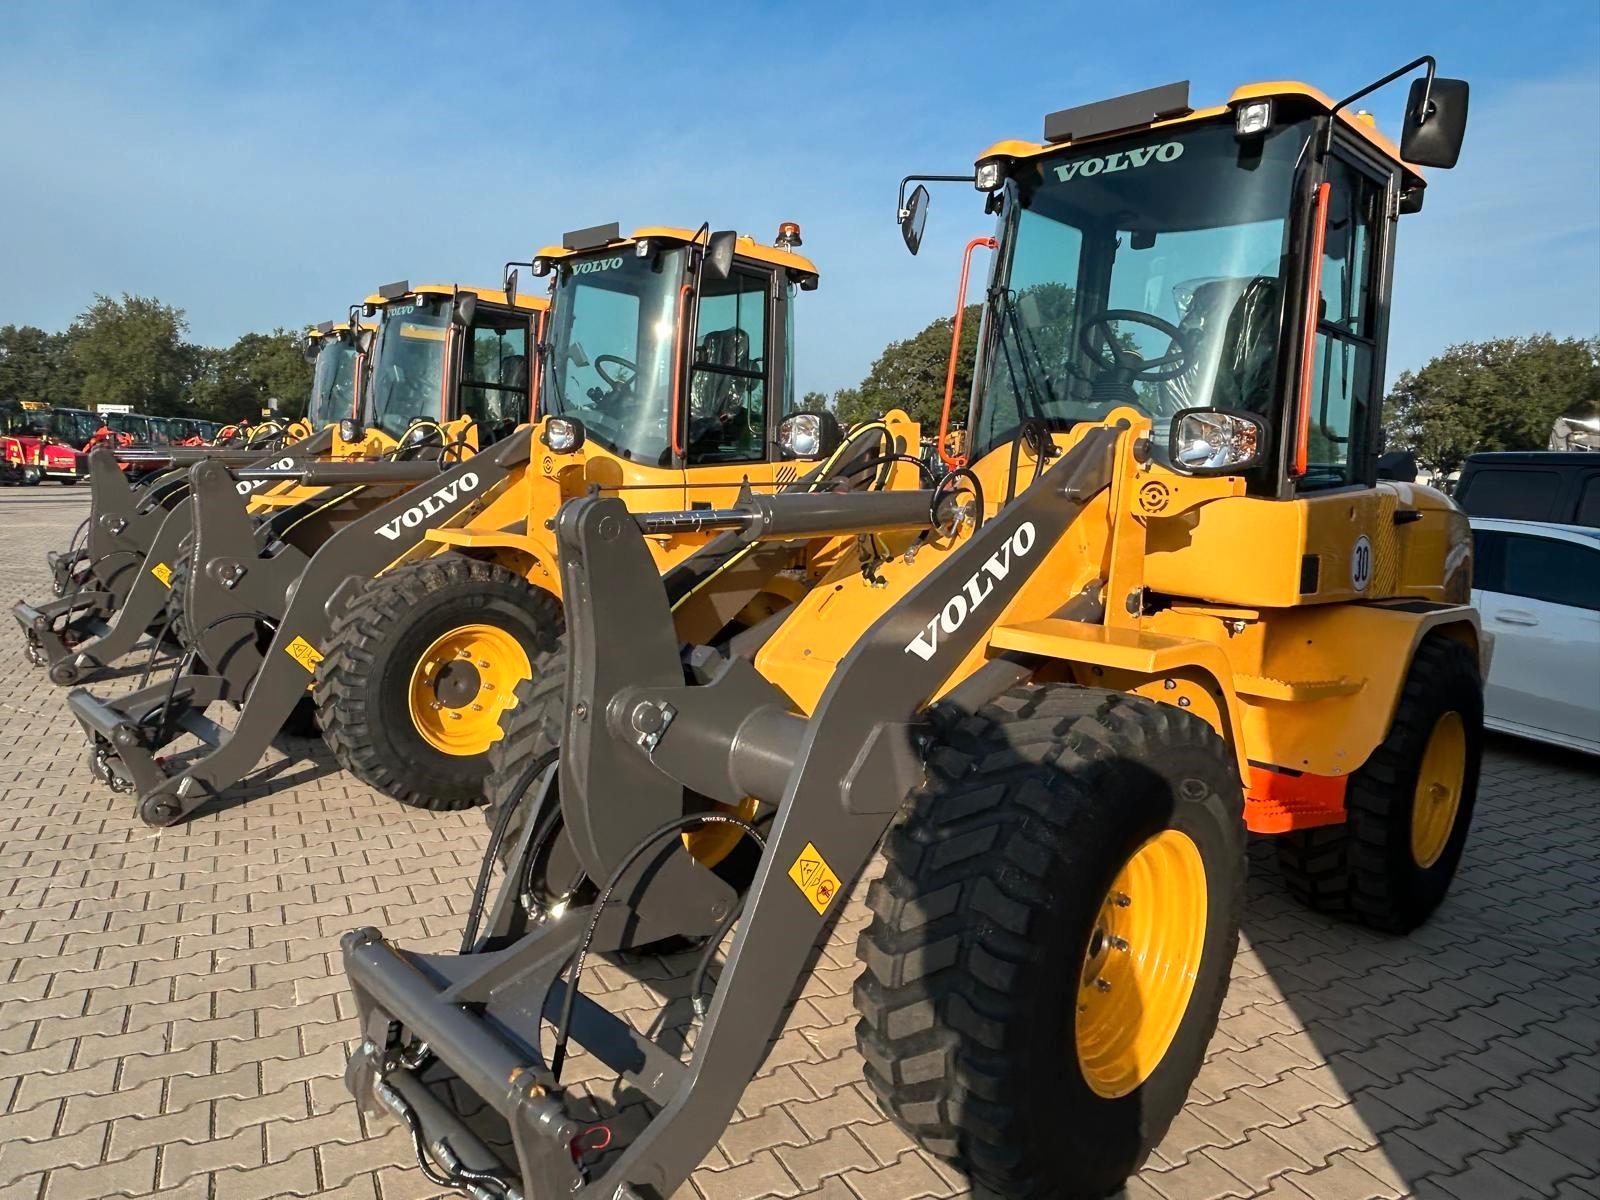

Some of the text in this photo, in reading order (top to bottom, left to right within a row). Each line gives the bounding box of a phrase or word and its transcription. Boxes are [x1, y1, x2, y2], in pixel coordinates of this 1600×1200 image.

[1053, 141, 1184, 183] VOLVO
[571, 257, 623, 276] VOLVO
[374, 471, 479, 541] VOLVO
[1354, 545, 1369, 582] 30
[905, 520, 1037, 662] VOLVO
